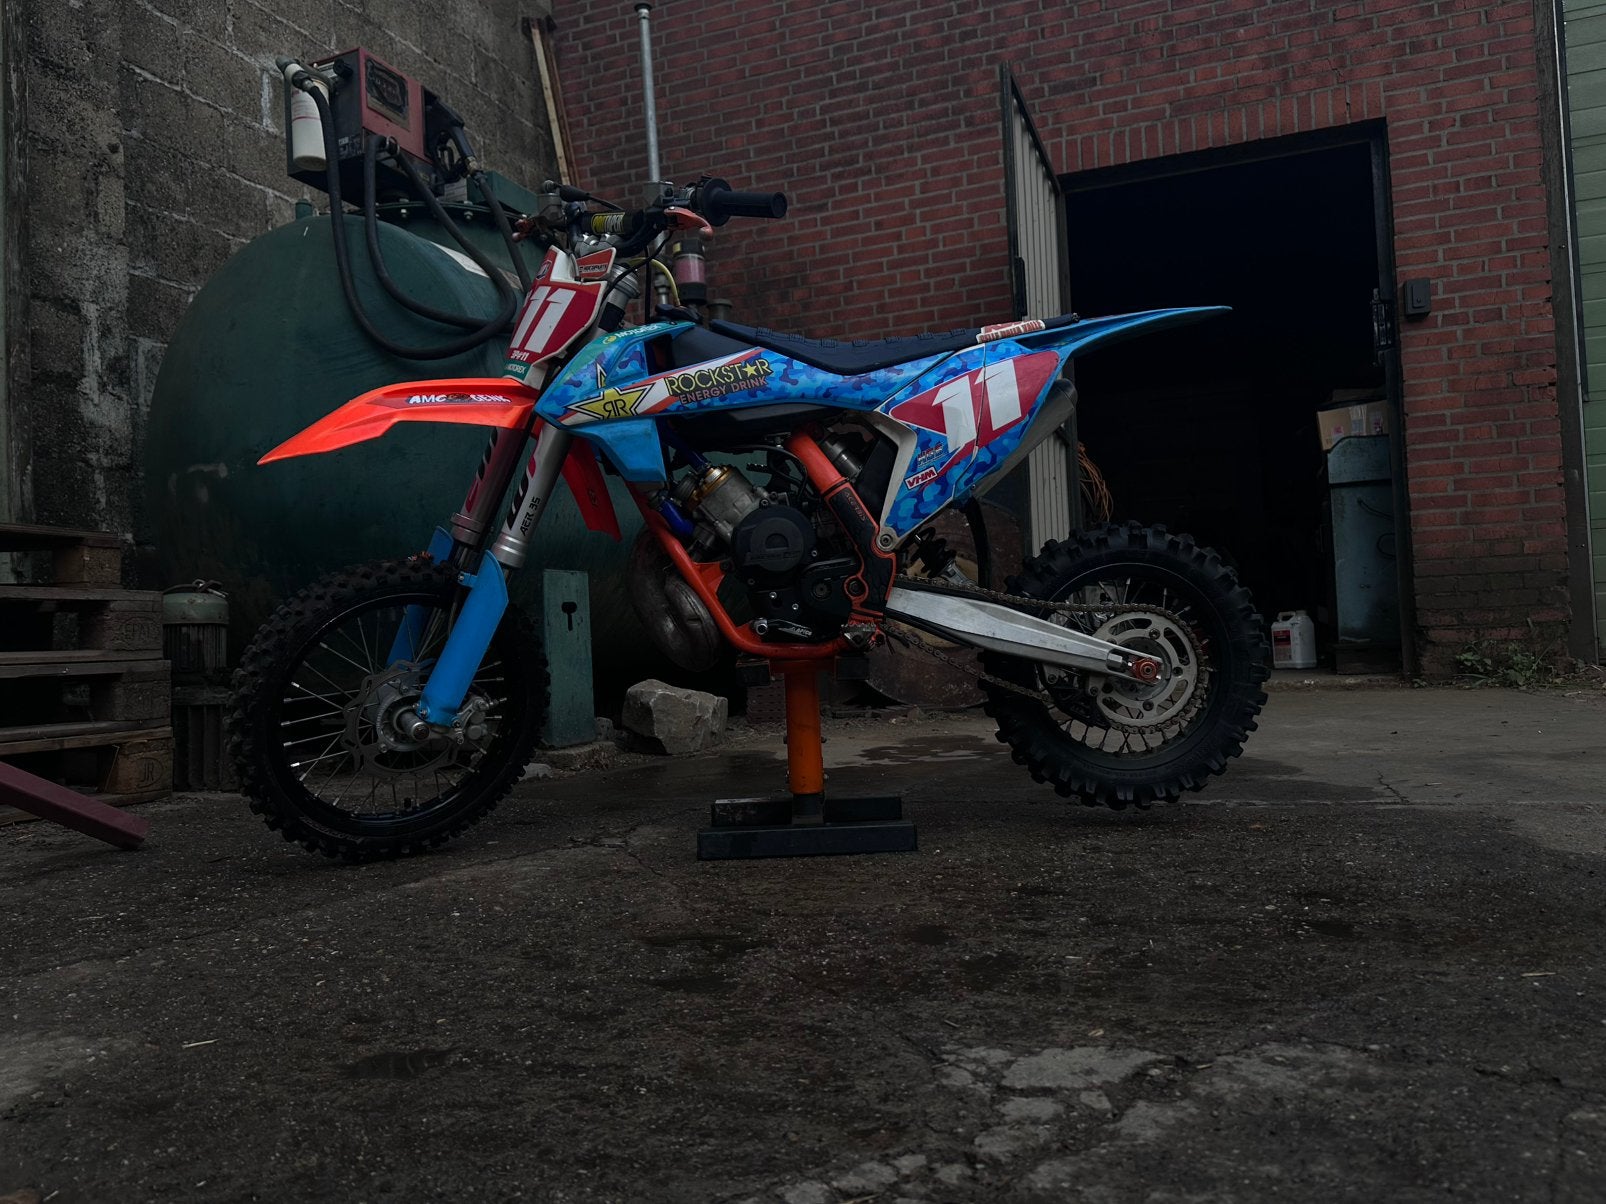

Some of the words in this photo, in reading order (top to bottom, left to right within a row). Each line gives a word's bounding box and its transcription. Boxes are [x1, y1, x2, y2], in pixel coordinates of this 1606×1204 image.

[509, 285, 577, 354] 11
[408, 394, 447, 404] AMC
[679, 385, 727, 405] ENERGY
[730, 376, 768, 393] DRINK
[932, 358, 1022, 452] 11
[907, 469, 937, 488] VHM
[520, 511, 534, 537] AER
[529, 496, 541, 511] 35
